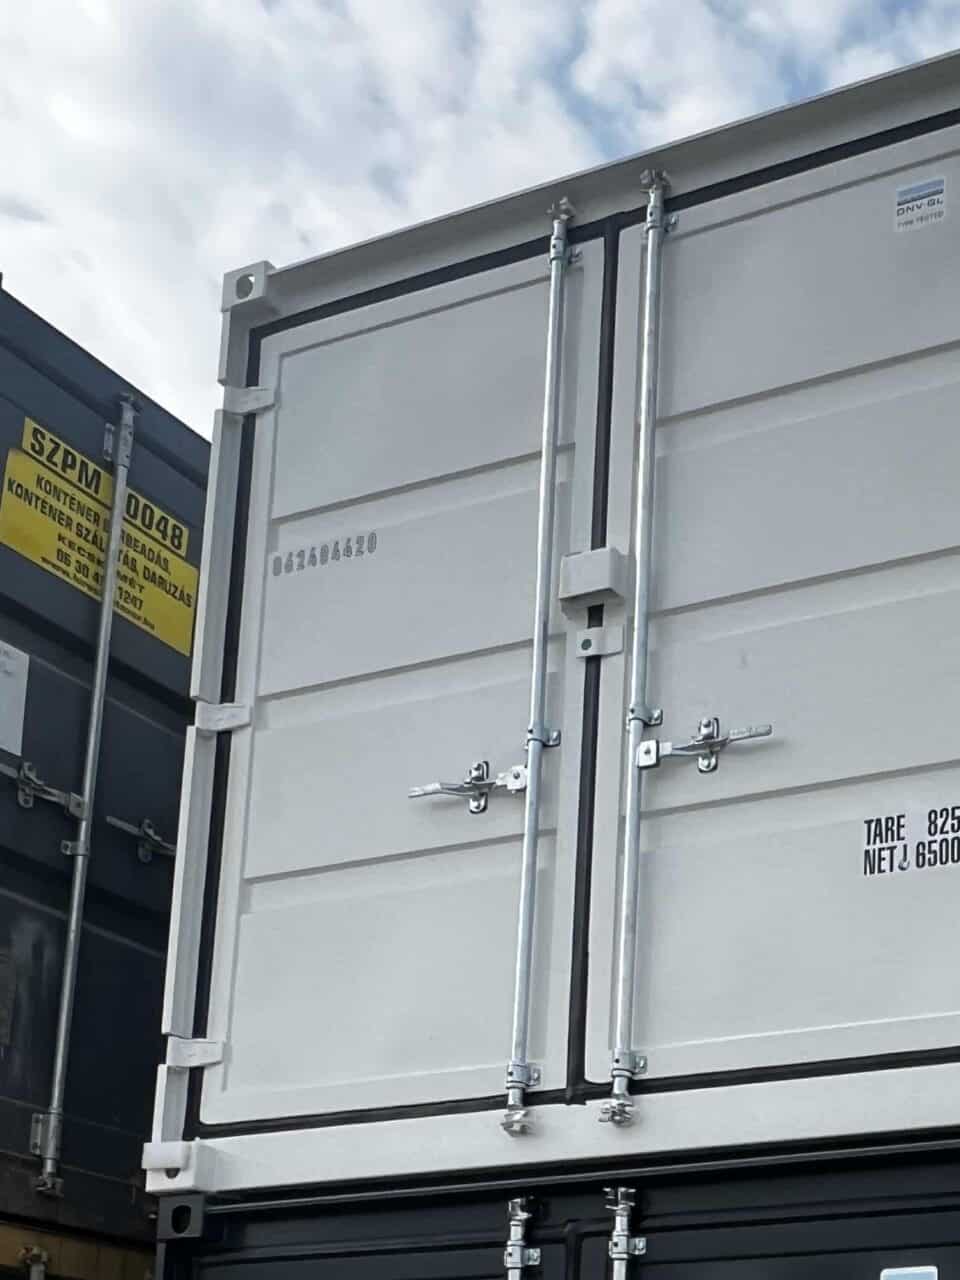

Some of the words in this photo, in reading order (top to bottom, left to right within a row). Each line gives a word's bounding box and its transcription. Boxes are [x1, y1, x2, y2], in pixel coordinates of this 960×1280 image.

[31, 427, 102, 496] SZPM
[126, 493, 184, 551] 0048
[864, 814, 905, 846] TARE
[928, 805, 960, 837] 825
[864, 845, 898, 875] NET
[916, 836, 960, 868] 6500
